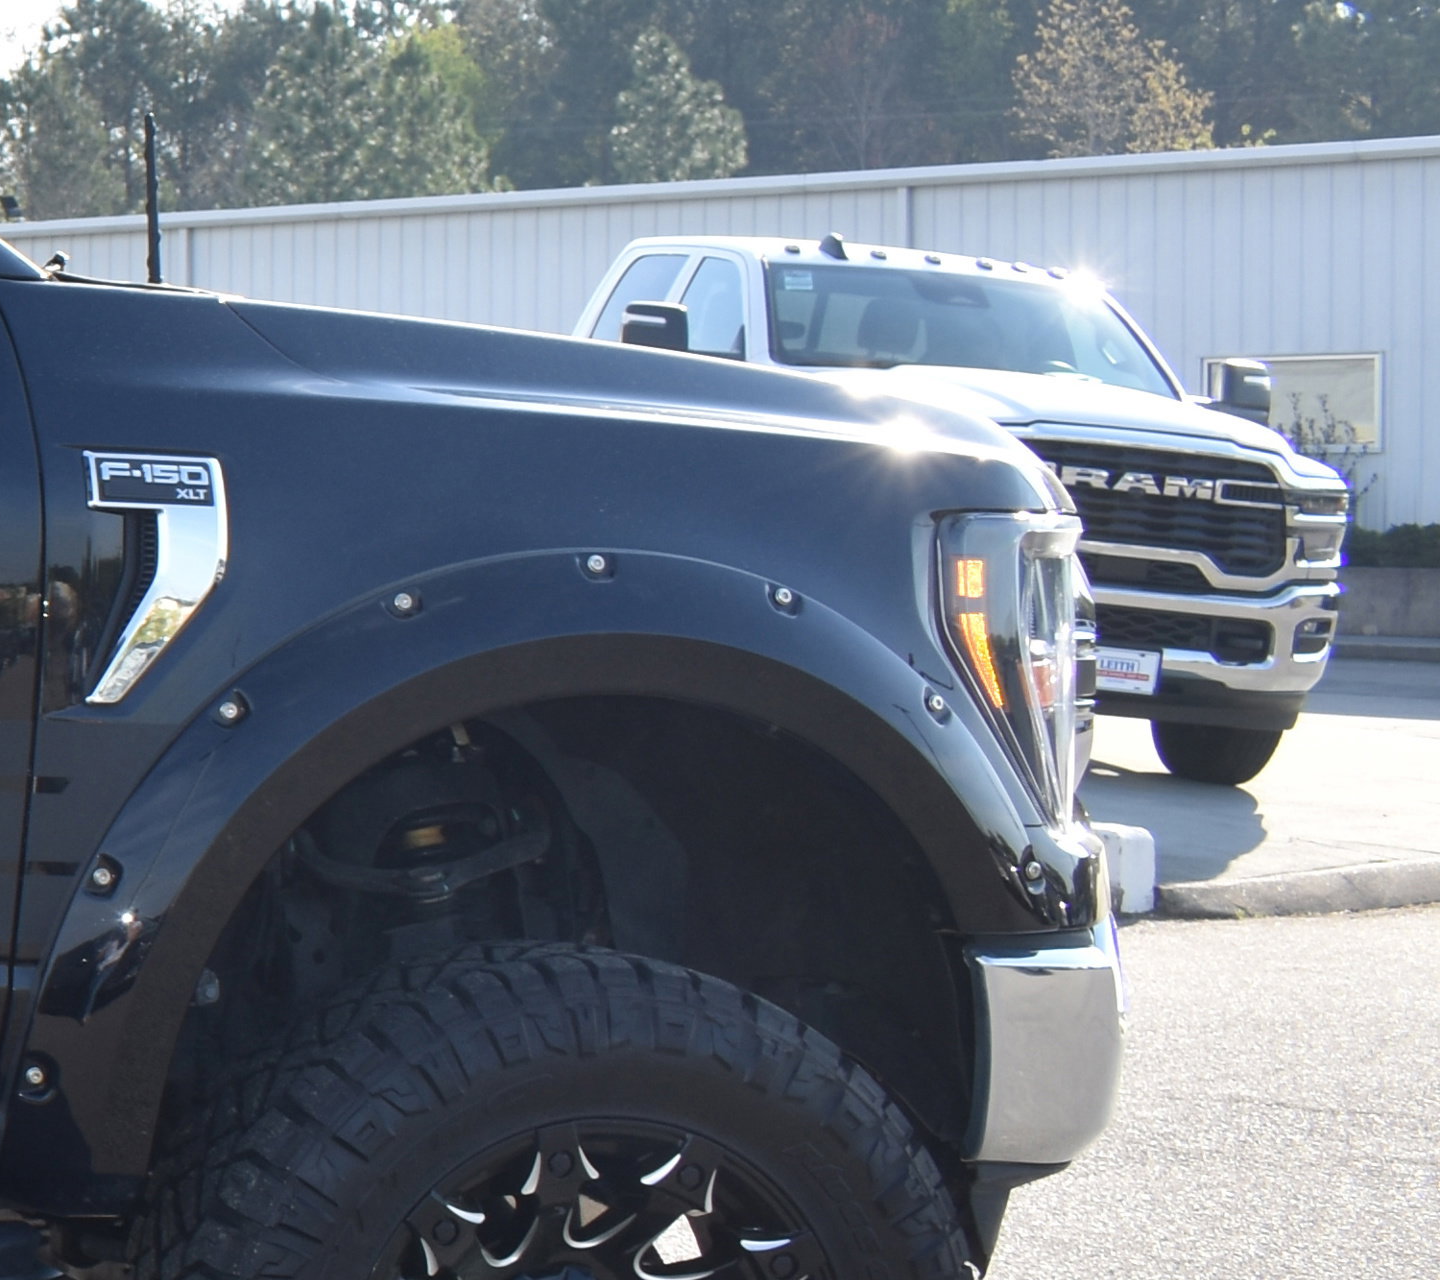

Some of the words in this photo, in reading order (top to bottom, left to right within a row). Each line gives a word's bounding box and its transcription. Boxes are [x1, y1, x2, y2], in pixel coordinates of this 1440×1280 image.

[100, 461, 209, 486] F-150
[1060, 465, 1215, 501] RAM
[176, 488, 208, 500] XLT
[1100, 659, 1136, 672] LEITH
